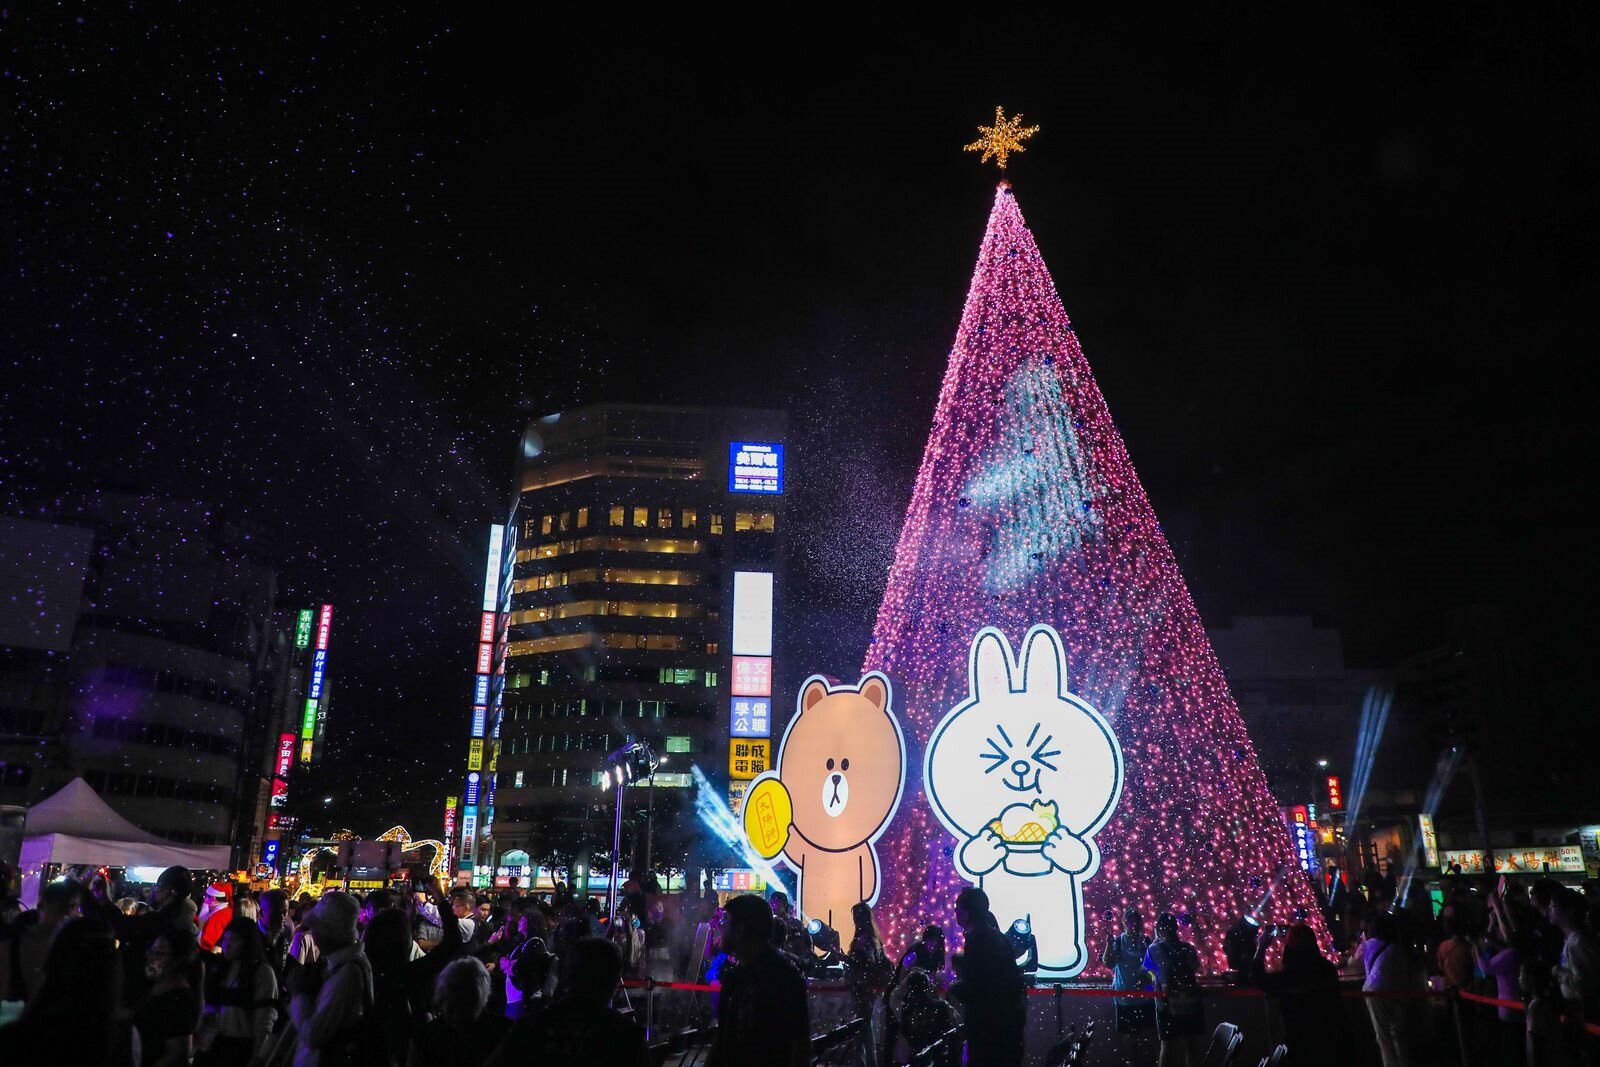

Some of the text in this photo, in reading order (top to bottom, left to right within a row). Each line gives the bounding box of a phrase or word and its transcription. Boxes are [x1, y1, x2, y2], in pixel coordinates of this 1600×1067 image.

[735, 702, 767, 717] 學儒
[735, 718, 767, 733] 公職
[735, 744, 765, 758] 聯成
[735, 759, 764, 773] 電腦
